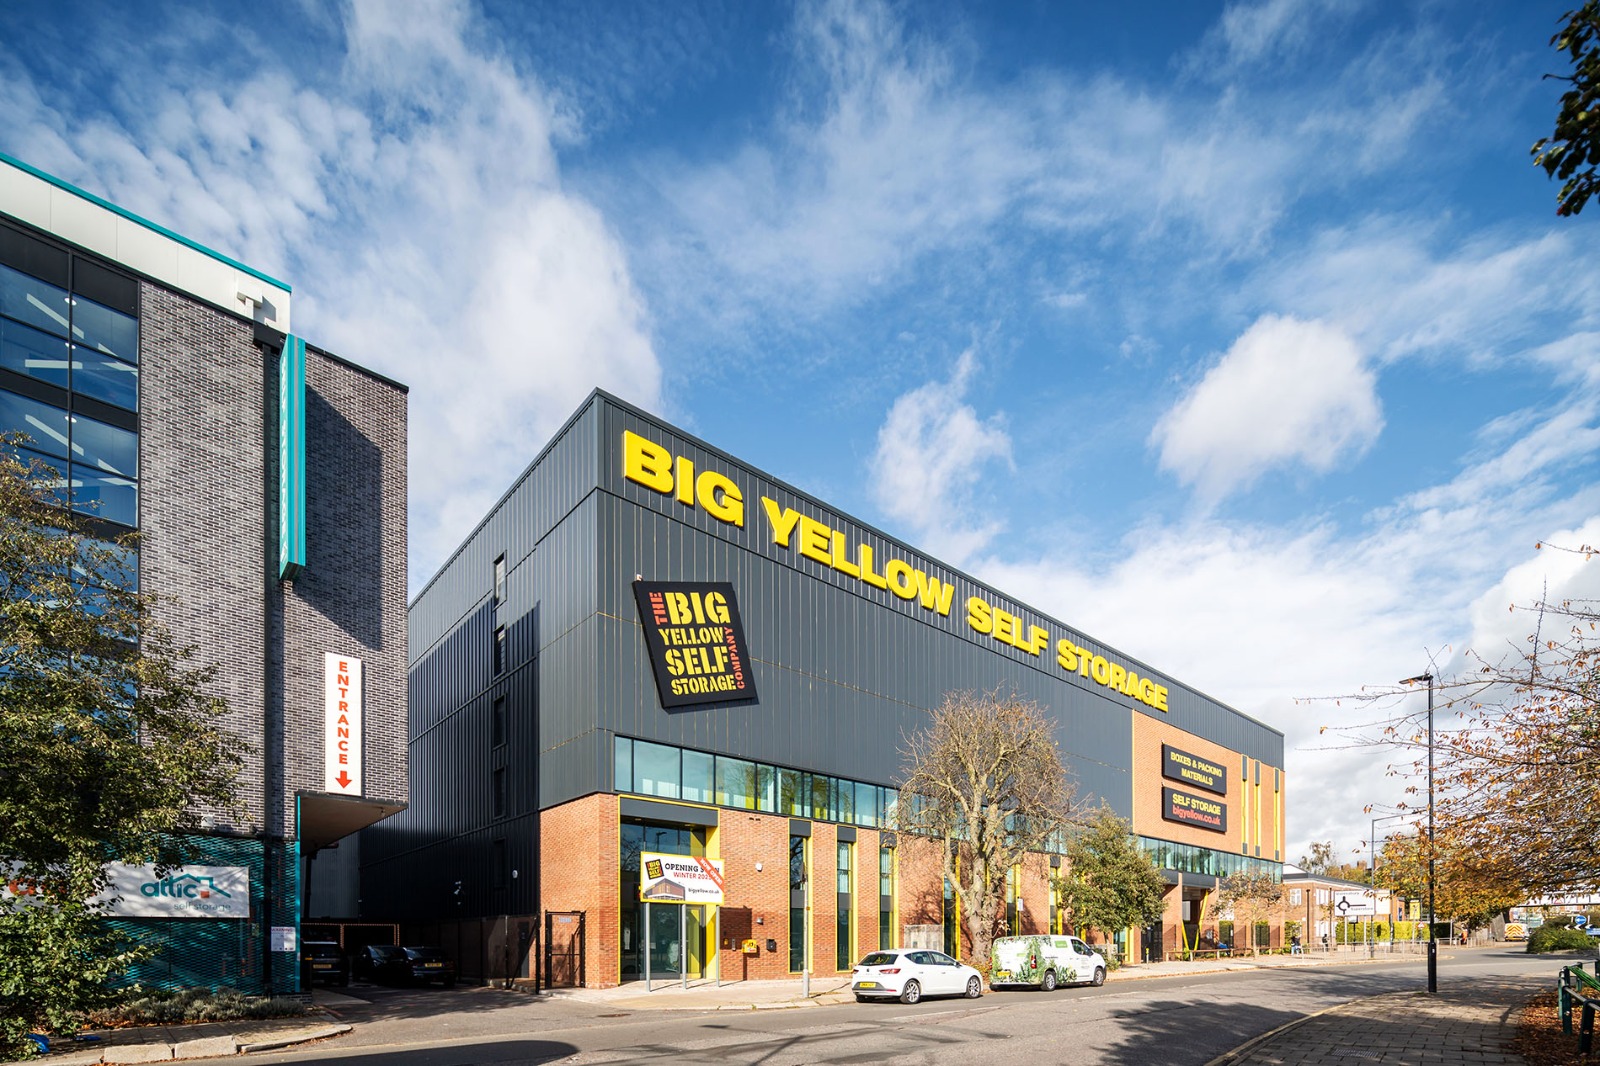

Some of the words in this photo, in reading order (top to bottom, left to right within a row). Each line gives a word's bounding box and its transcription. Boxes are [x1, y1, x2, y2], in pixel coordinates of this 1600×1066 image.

[622, 429, 744, 527] BIG
[761, 496, 955, 616] YELLOW
[965, 596, 1048, 656] SELF
[1057, 639, 1168, 713] STORAGE
[649, 592, 668, 625] THE
[664, 591, 731, 625] BIG
[658, 627, 724, 646] YELLOW
[665, 646, 728, 676] SELF
[724, 626, 745, 689] COMPANY
[671, 674, 737, 695] STORAGE
[337, 661, 349, 765] ENTRANCE
[1170, 752, 1191, 767] BOXES
[1192, 760, 1197, 769] &
[1197, 761, 1222, 777] PACKING
[1181, 768, 1213, 786] MATERIALS
[1172, 793, 1190, 807] SELF
[1191, 798, 1221, 815] STORAGE
[1172, 804, 1220, 826] bigyellow.co.uk
[665, 863, 698, 872] OPENING
[673, 871, 696, 879] WINTER
[140, 875, 197, 898] attic
[174, 901, 191, 910] self
[194, 902, 231, 912] storage
